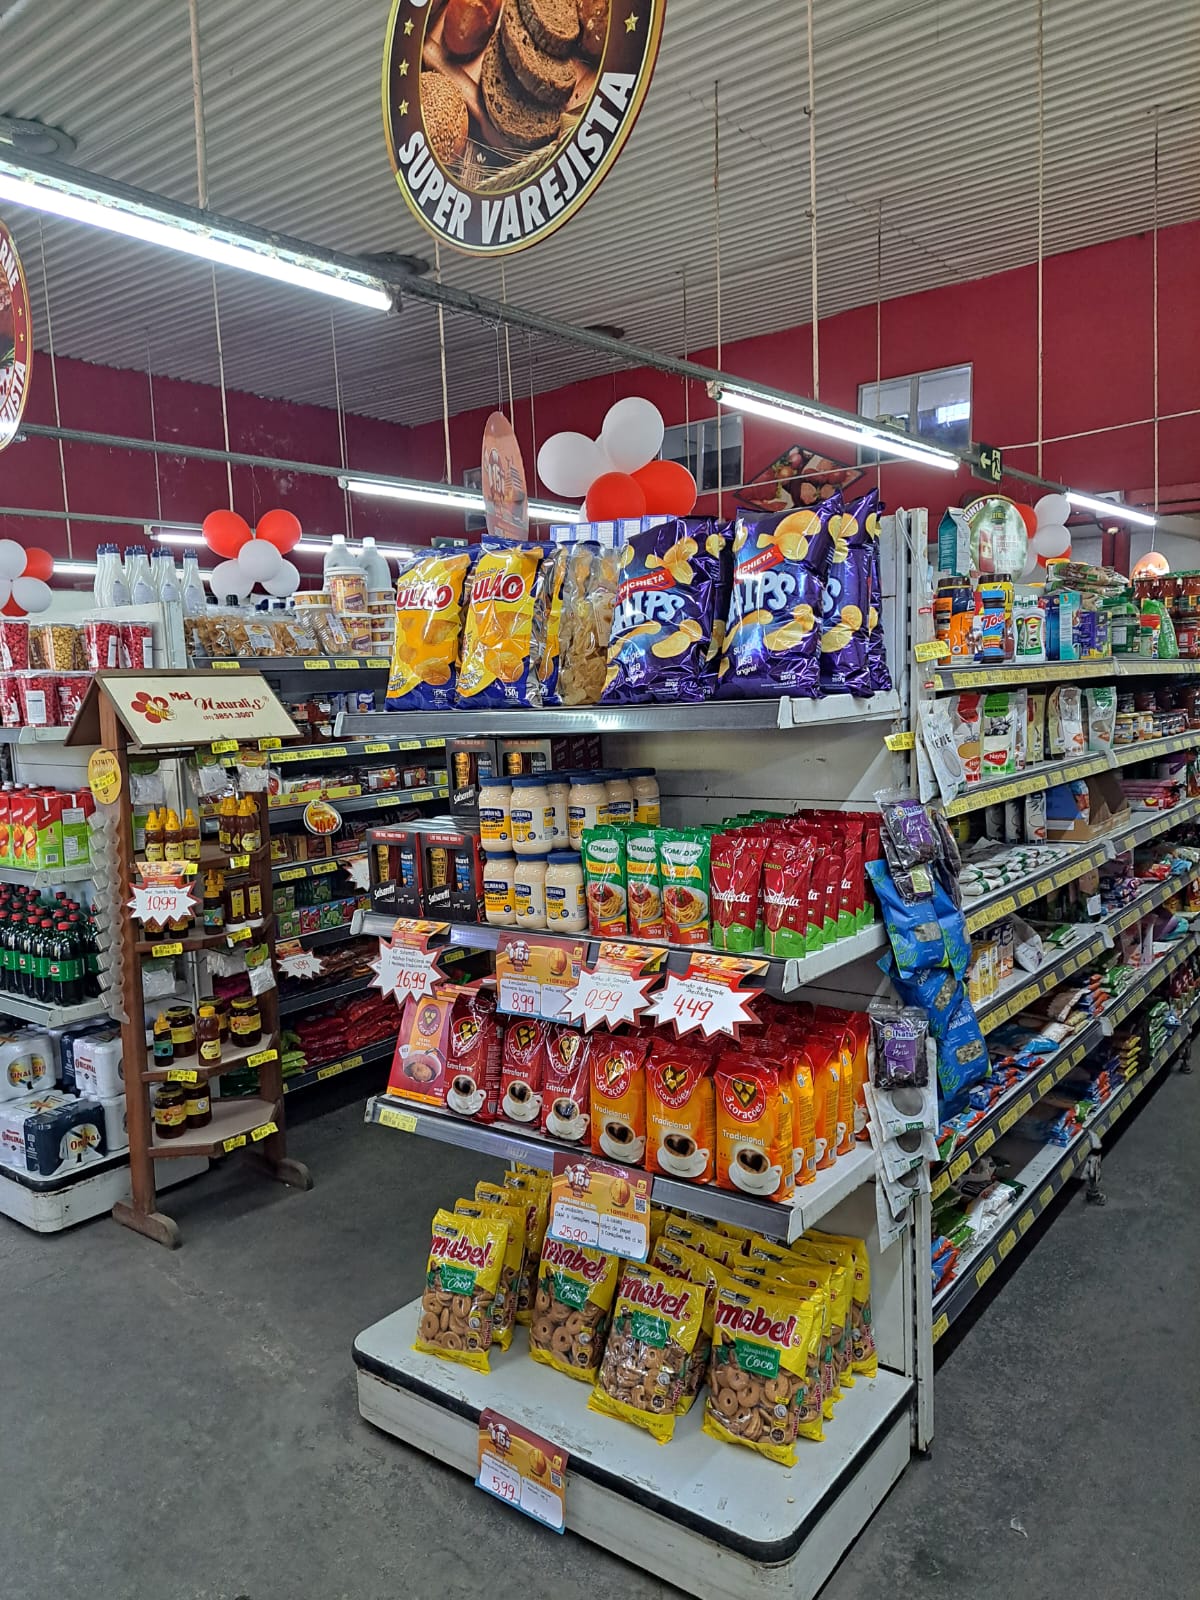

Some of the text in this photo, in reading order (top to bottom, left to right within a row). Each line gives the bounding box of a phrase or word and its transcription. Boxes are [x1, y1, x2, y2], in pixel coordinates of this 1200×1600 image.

[399, 71, 637, 244] SUPER VAREJISTA
[168, 691, 192, 701] Mel
[146, 895, 177, 911] 10,99
[396, 969, 427, 989] 16,99
[511, 992, 535, 1013] 8,99
[584, 988, 623, 1012] 0,99
[673, 994, 714, 1021] 4,49
[546, 1082, 574, 1095] Extrafor
[593, 1103, 631, 1120] Tradicional
[725, 1095, 764, 1120] 3 corações
[652, 1114, 692, 1130] Tradicional
[722, 1128, 765, 1147] Tradicional
[574, 1171, 585, 1187] 15
[558, 1224, 588, 1242] 25,90
[431, 1233, 493, 1269] mabel
[541, 1237, 607, 1282] mabel
[618, 1274, 691, 1321] mabel
[715, 1298, 798, 1348] mabel
[745, 1353, 775, 1372] Coco
[496, 1430, 506, 1447] 15
[492, 1475, 515, 1501] 5,99
